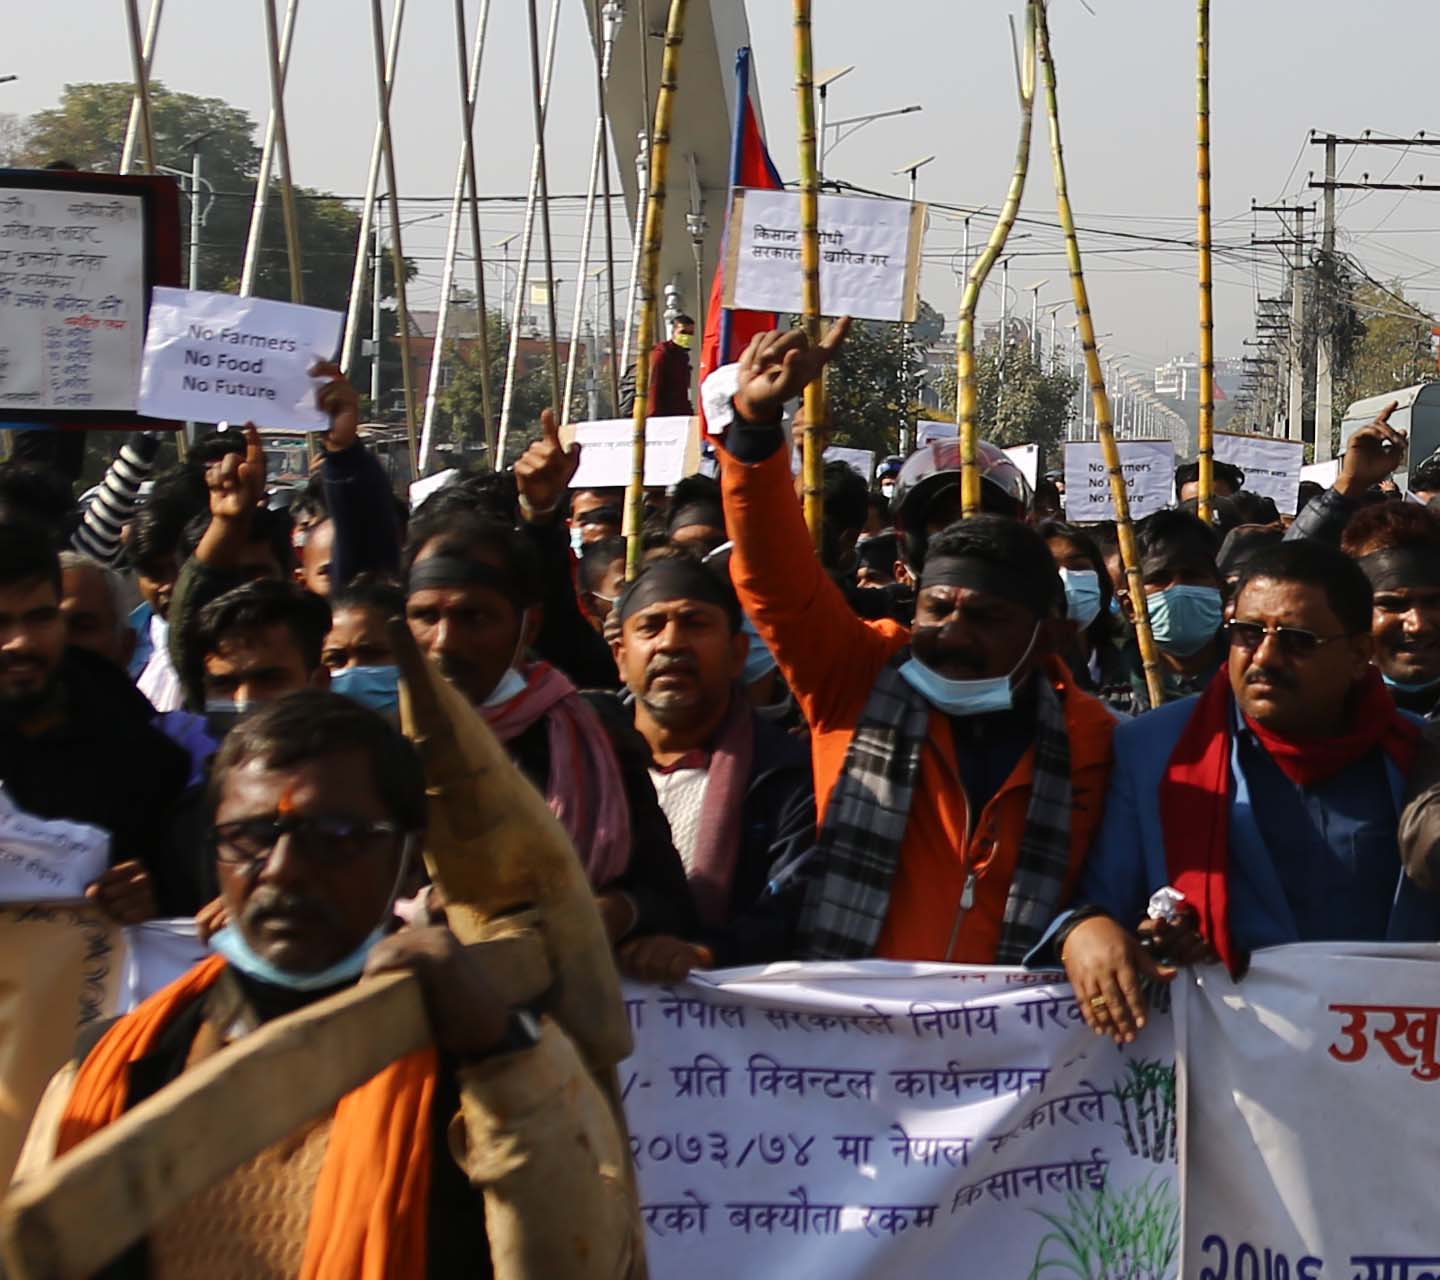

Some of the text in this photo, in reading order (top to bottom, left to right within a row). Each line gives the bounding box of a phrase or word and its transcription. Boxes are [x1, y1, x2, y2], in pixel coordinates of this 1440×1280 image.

[187, 325, 296, 352] No Farmers
[185, 350, 264, 374] No Food
[182, 376, 277, 400] No Future
[1089, 463, 1104, 472] No
[1089, 478, 1104, 487] No
[1089, 494, 1104, 502] No
[670, 1054, 730, 1098] प्रति
[833, 1136, 875, 1167] मा
[889, 1124, 972, 1168] नेपाल
[725, 1186, 841, 1235] बक्यौता
[862, 1205, 938, 1238] रकम
